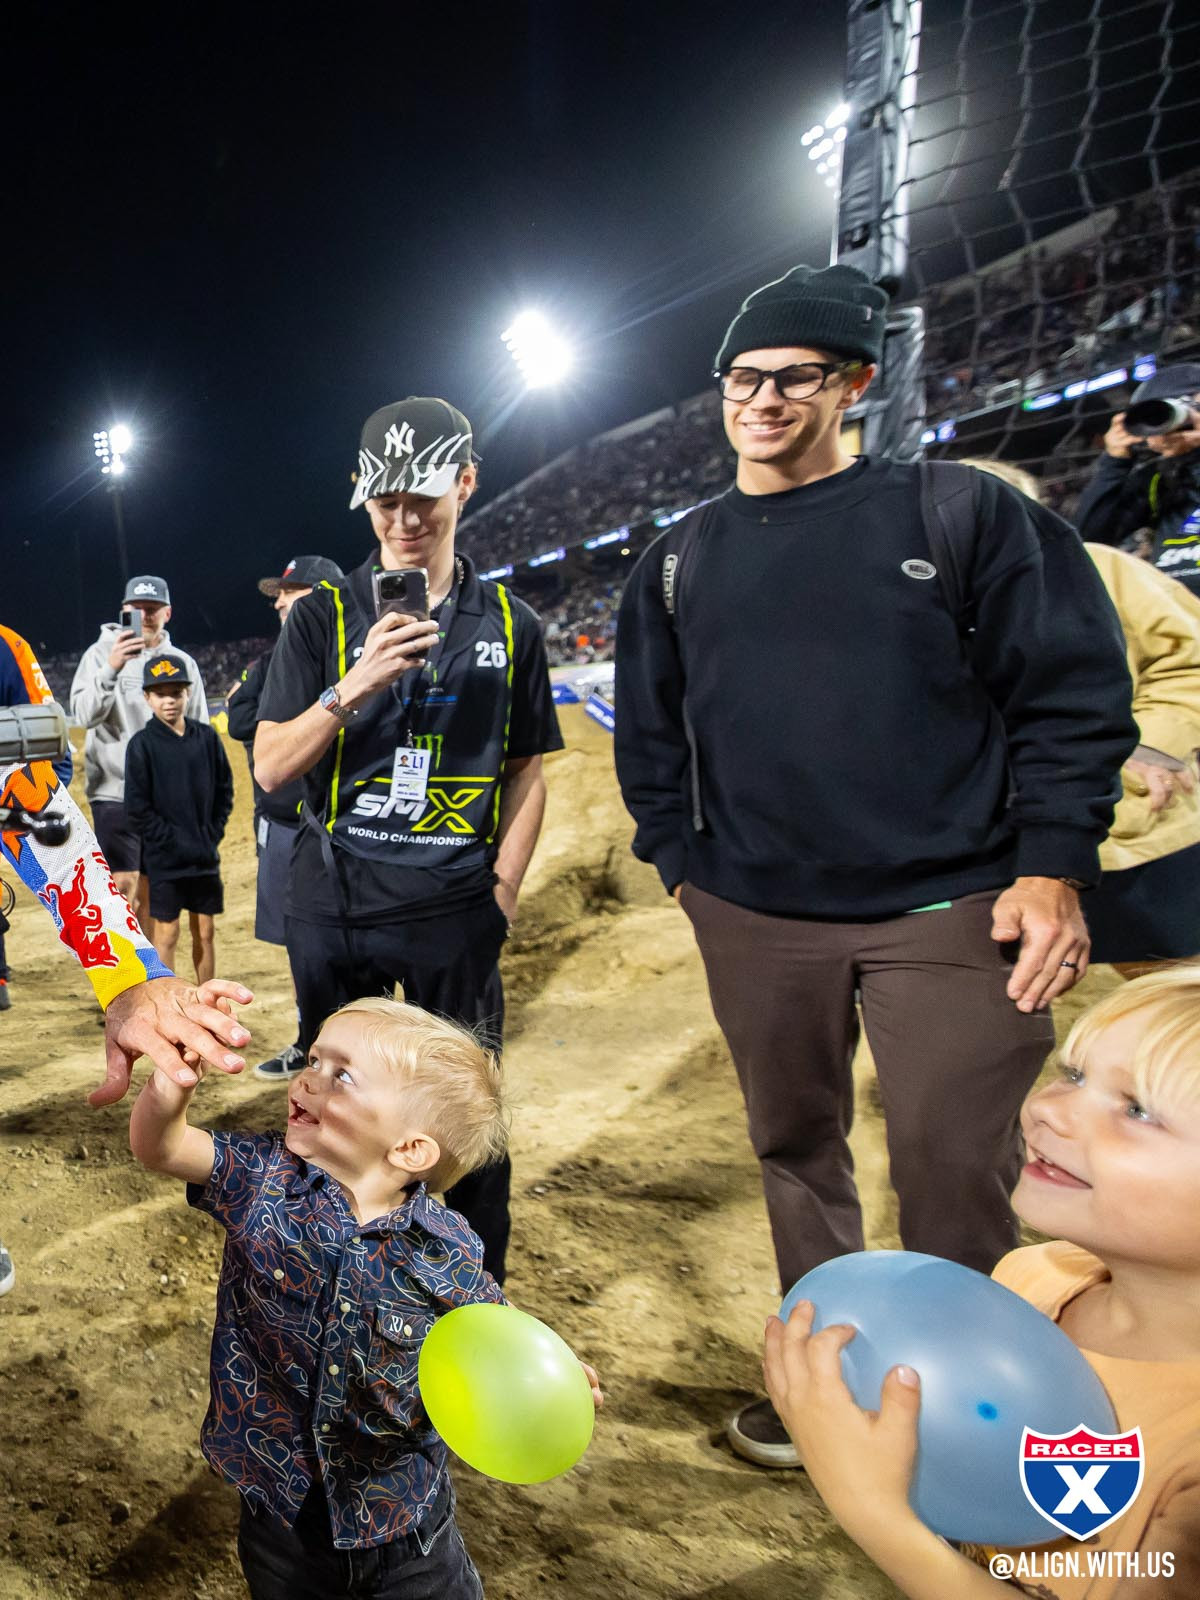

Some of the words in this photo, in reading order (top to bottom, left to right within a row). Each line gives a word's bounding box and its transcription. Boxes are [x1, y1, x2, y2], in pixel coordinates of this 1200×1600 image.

[384, 421, 416, 458] NY
[474, 640, 508, 668] 26
[351, 787, 485, 834] SMX
[347, 826, 389, 841] WORLD
[389, 833, 478, 847] CHAMPIONSH
